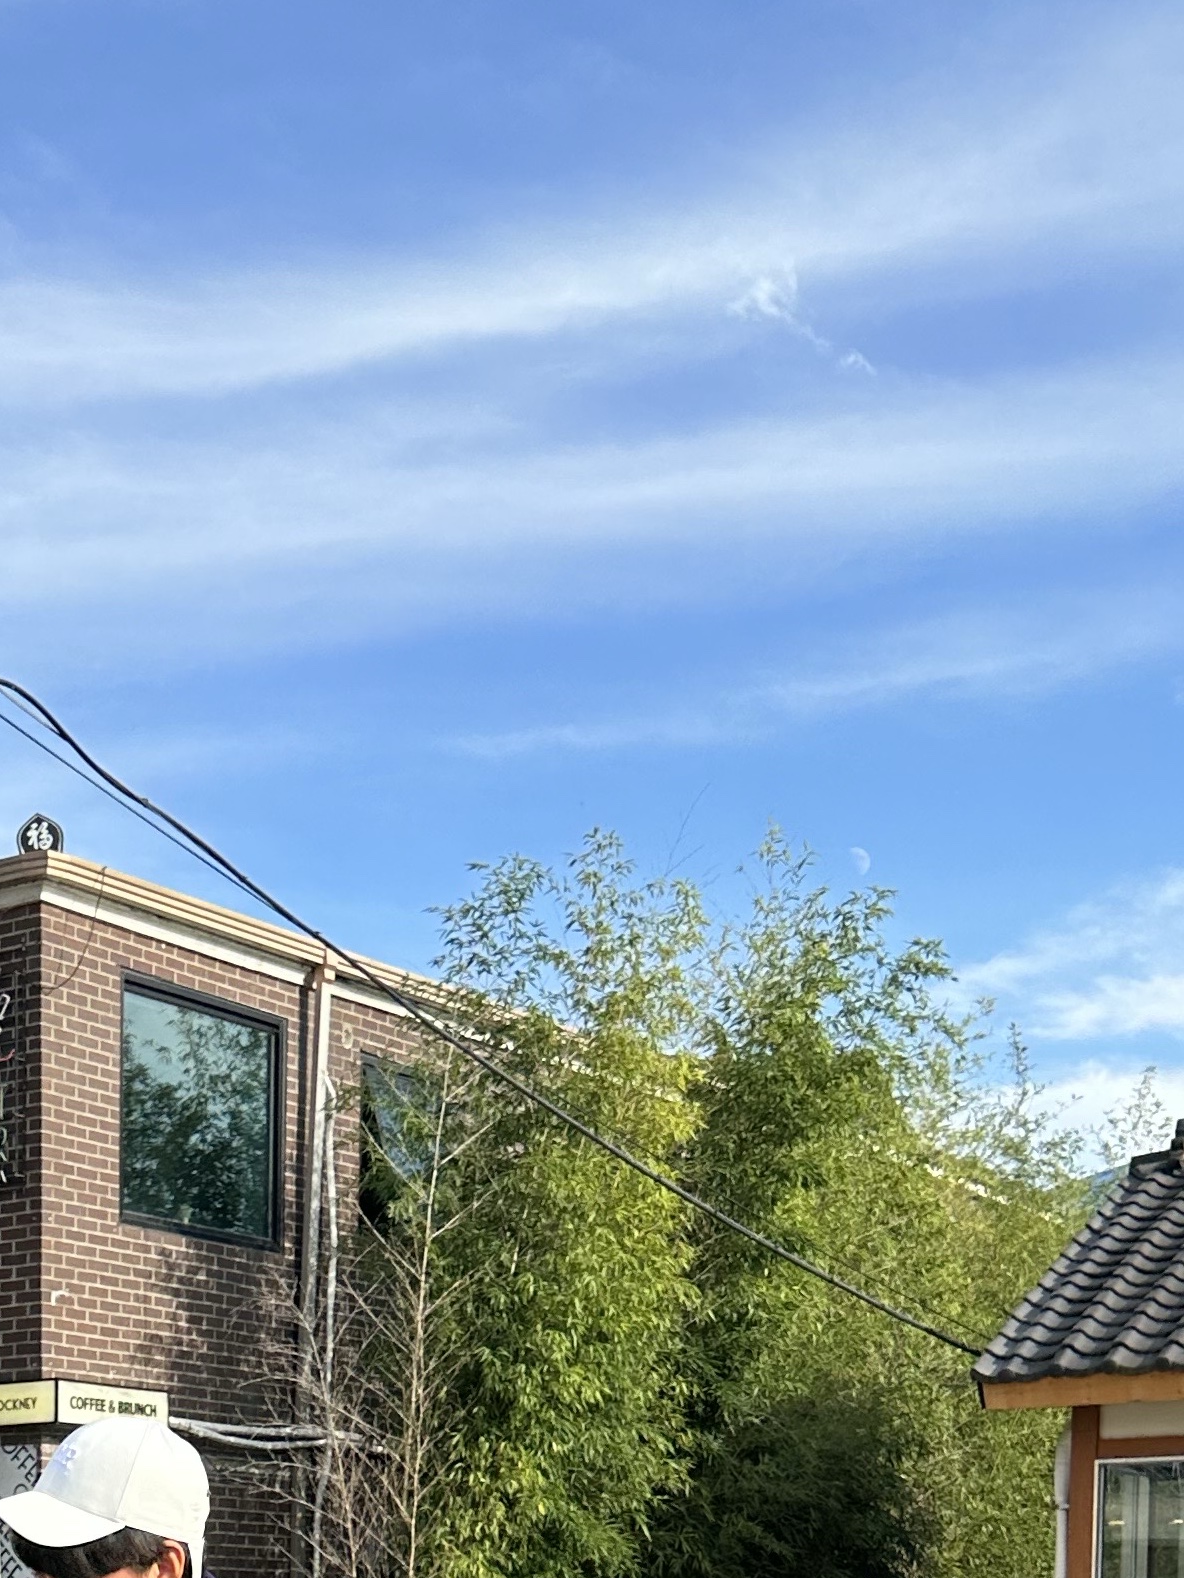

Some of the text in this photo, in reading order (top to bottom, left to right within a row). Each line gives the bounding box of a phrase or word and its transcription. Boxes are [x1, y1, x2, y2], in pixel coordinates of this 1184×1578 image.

[26, 821, 54, 851] 福
[69, 1396, 157, 1417] COFFEE & BRUNCH
